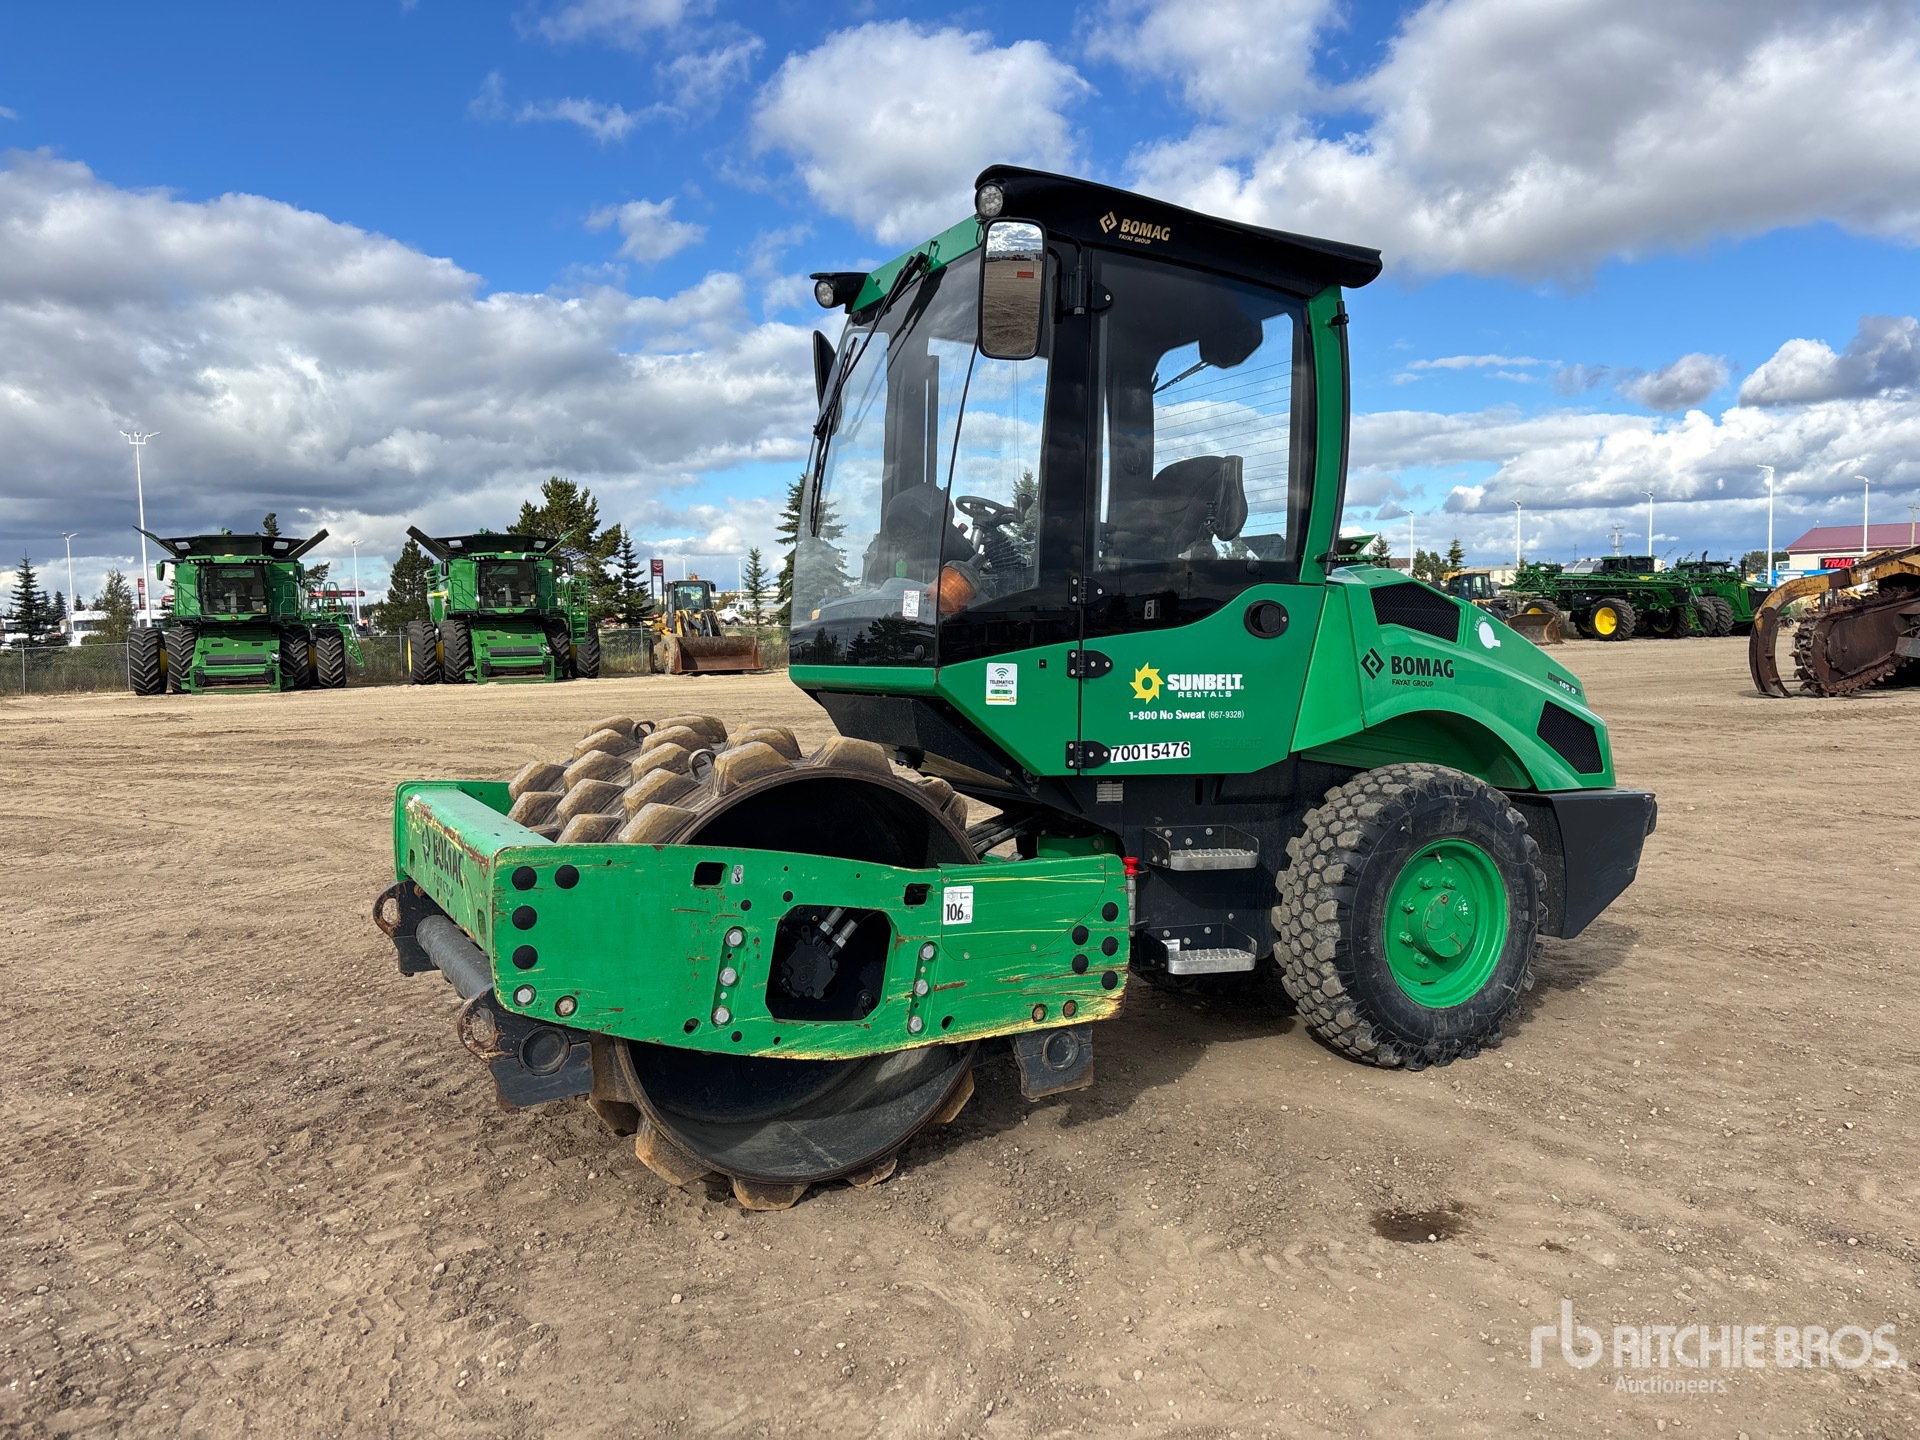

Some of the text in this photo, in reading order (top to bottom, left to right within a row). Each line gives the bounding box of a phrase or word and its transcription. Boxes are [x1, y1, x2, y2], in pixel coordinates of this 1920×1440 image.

[1120, 218, 1171, 241] BOMAG
[1118, 233, 1151, 244] FAYAT GROUP
[1391, 655, 1454, 678] BOMAG
[1167, 674, 1243, 690] SUNBELT
[1412, 679, 1434, 687] GROUP
[1177, 690, 1232, 698] RENTALS
[1128, 709, 1245, 720] 1-800 No Sweat (667-9328)
[1112, 741, 1190, 762] 70015476
[946, 903, 964, 921] 106
